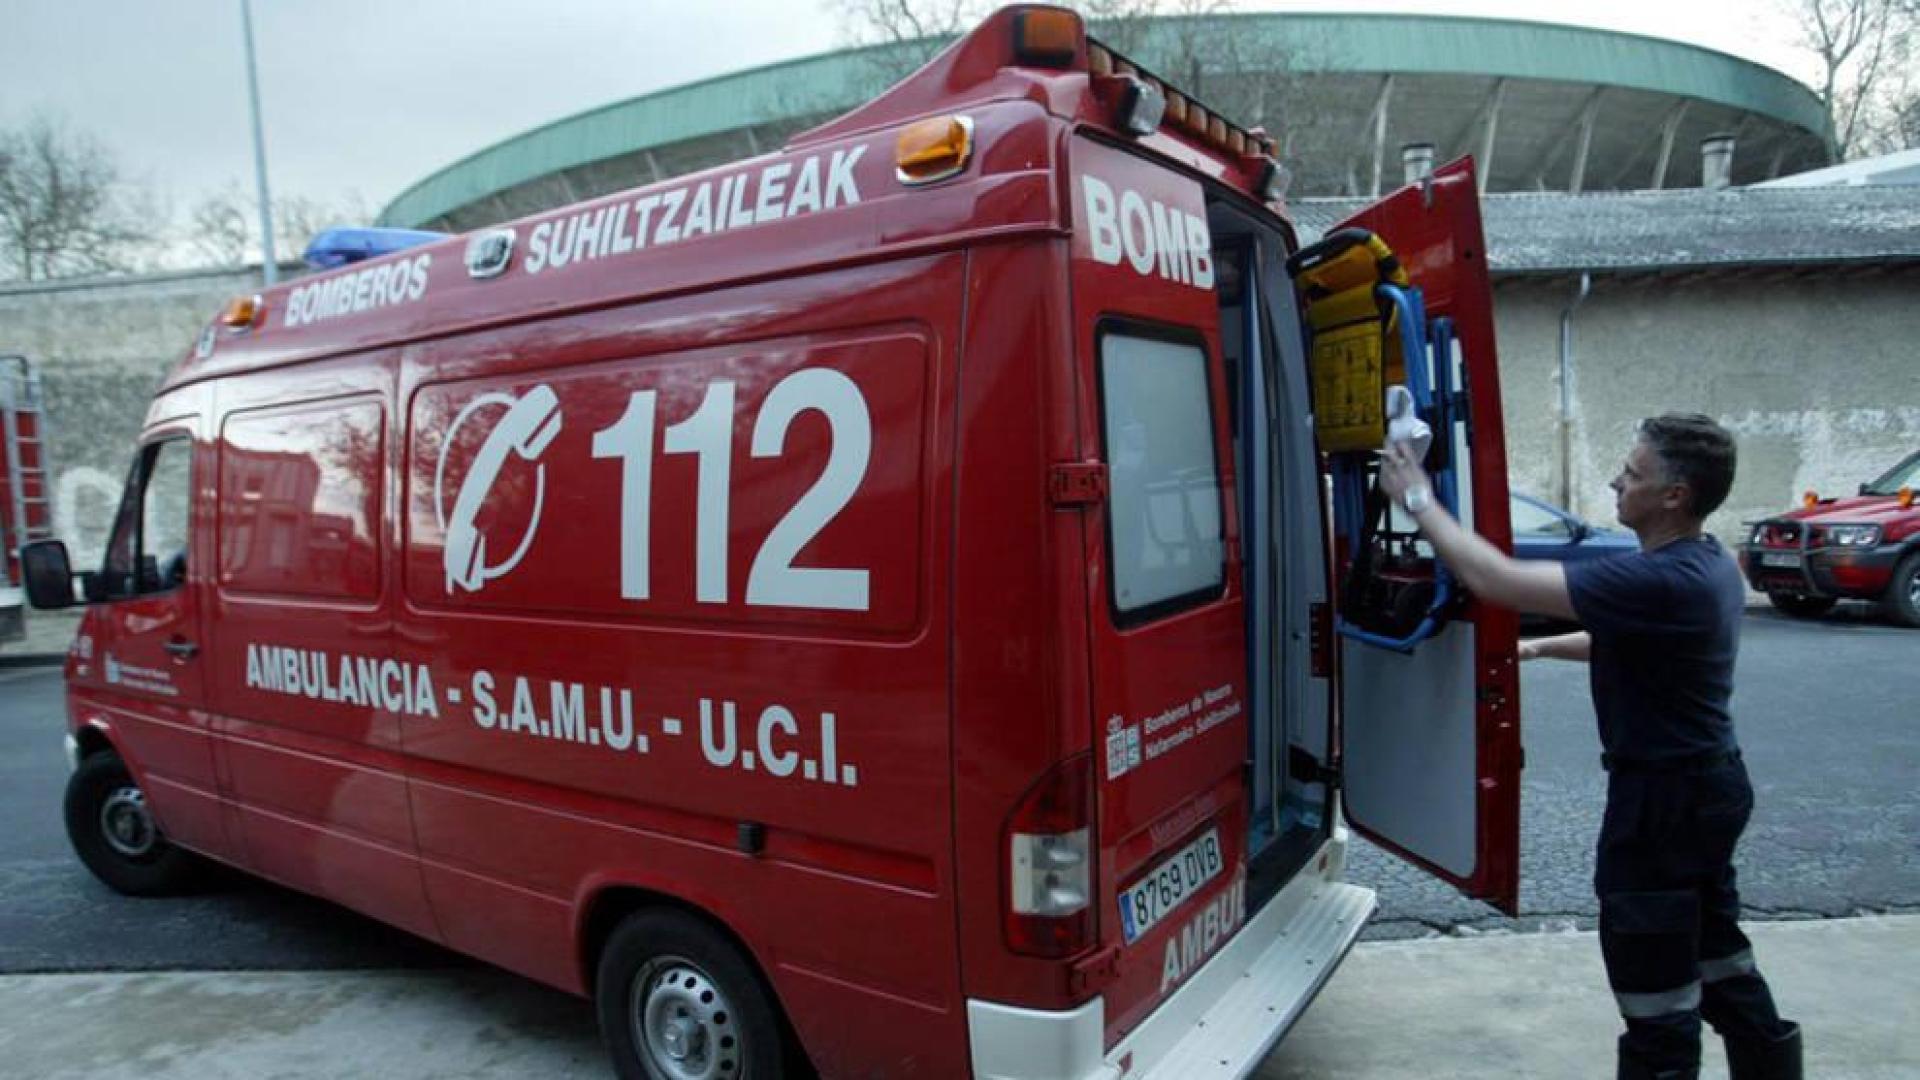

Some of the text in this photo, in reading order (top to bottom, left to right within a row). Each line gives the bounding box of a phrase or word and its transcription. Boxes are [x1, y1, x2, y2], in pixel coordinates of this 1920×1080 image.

[285, 145, 867, 326] BOMBEROS SUHILTZAILEAK
[1083, 174, 1215, 289] BOMB
[592, 366, 871, 611] 112
[246, 643, 439, 718] AMBULANCIA
[472, 670, 649, 753] S.A.M.U.
[700, 698, 858, 786] U.C.I.
[1134, 837, 1220, 926] 8769 DVB
